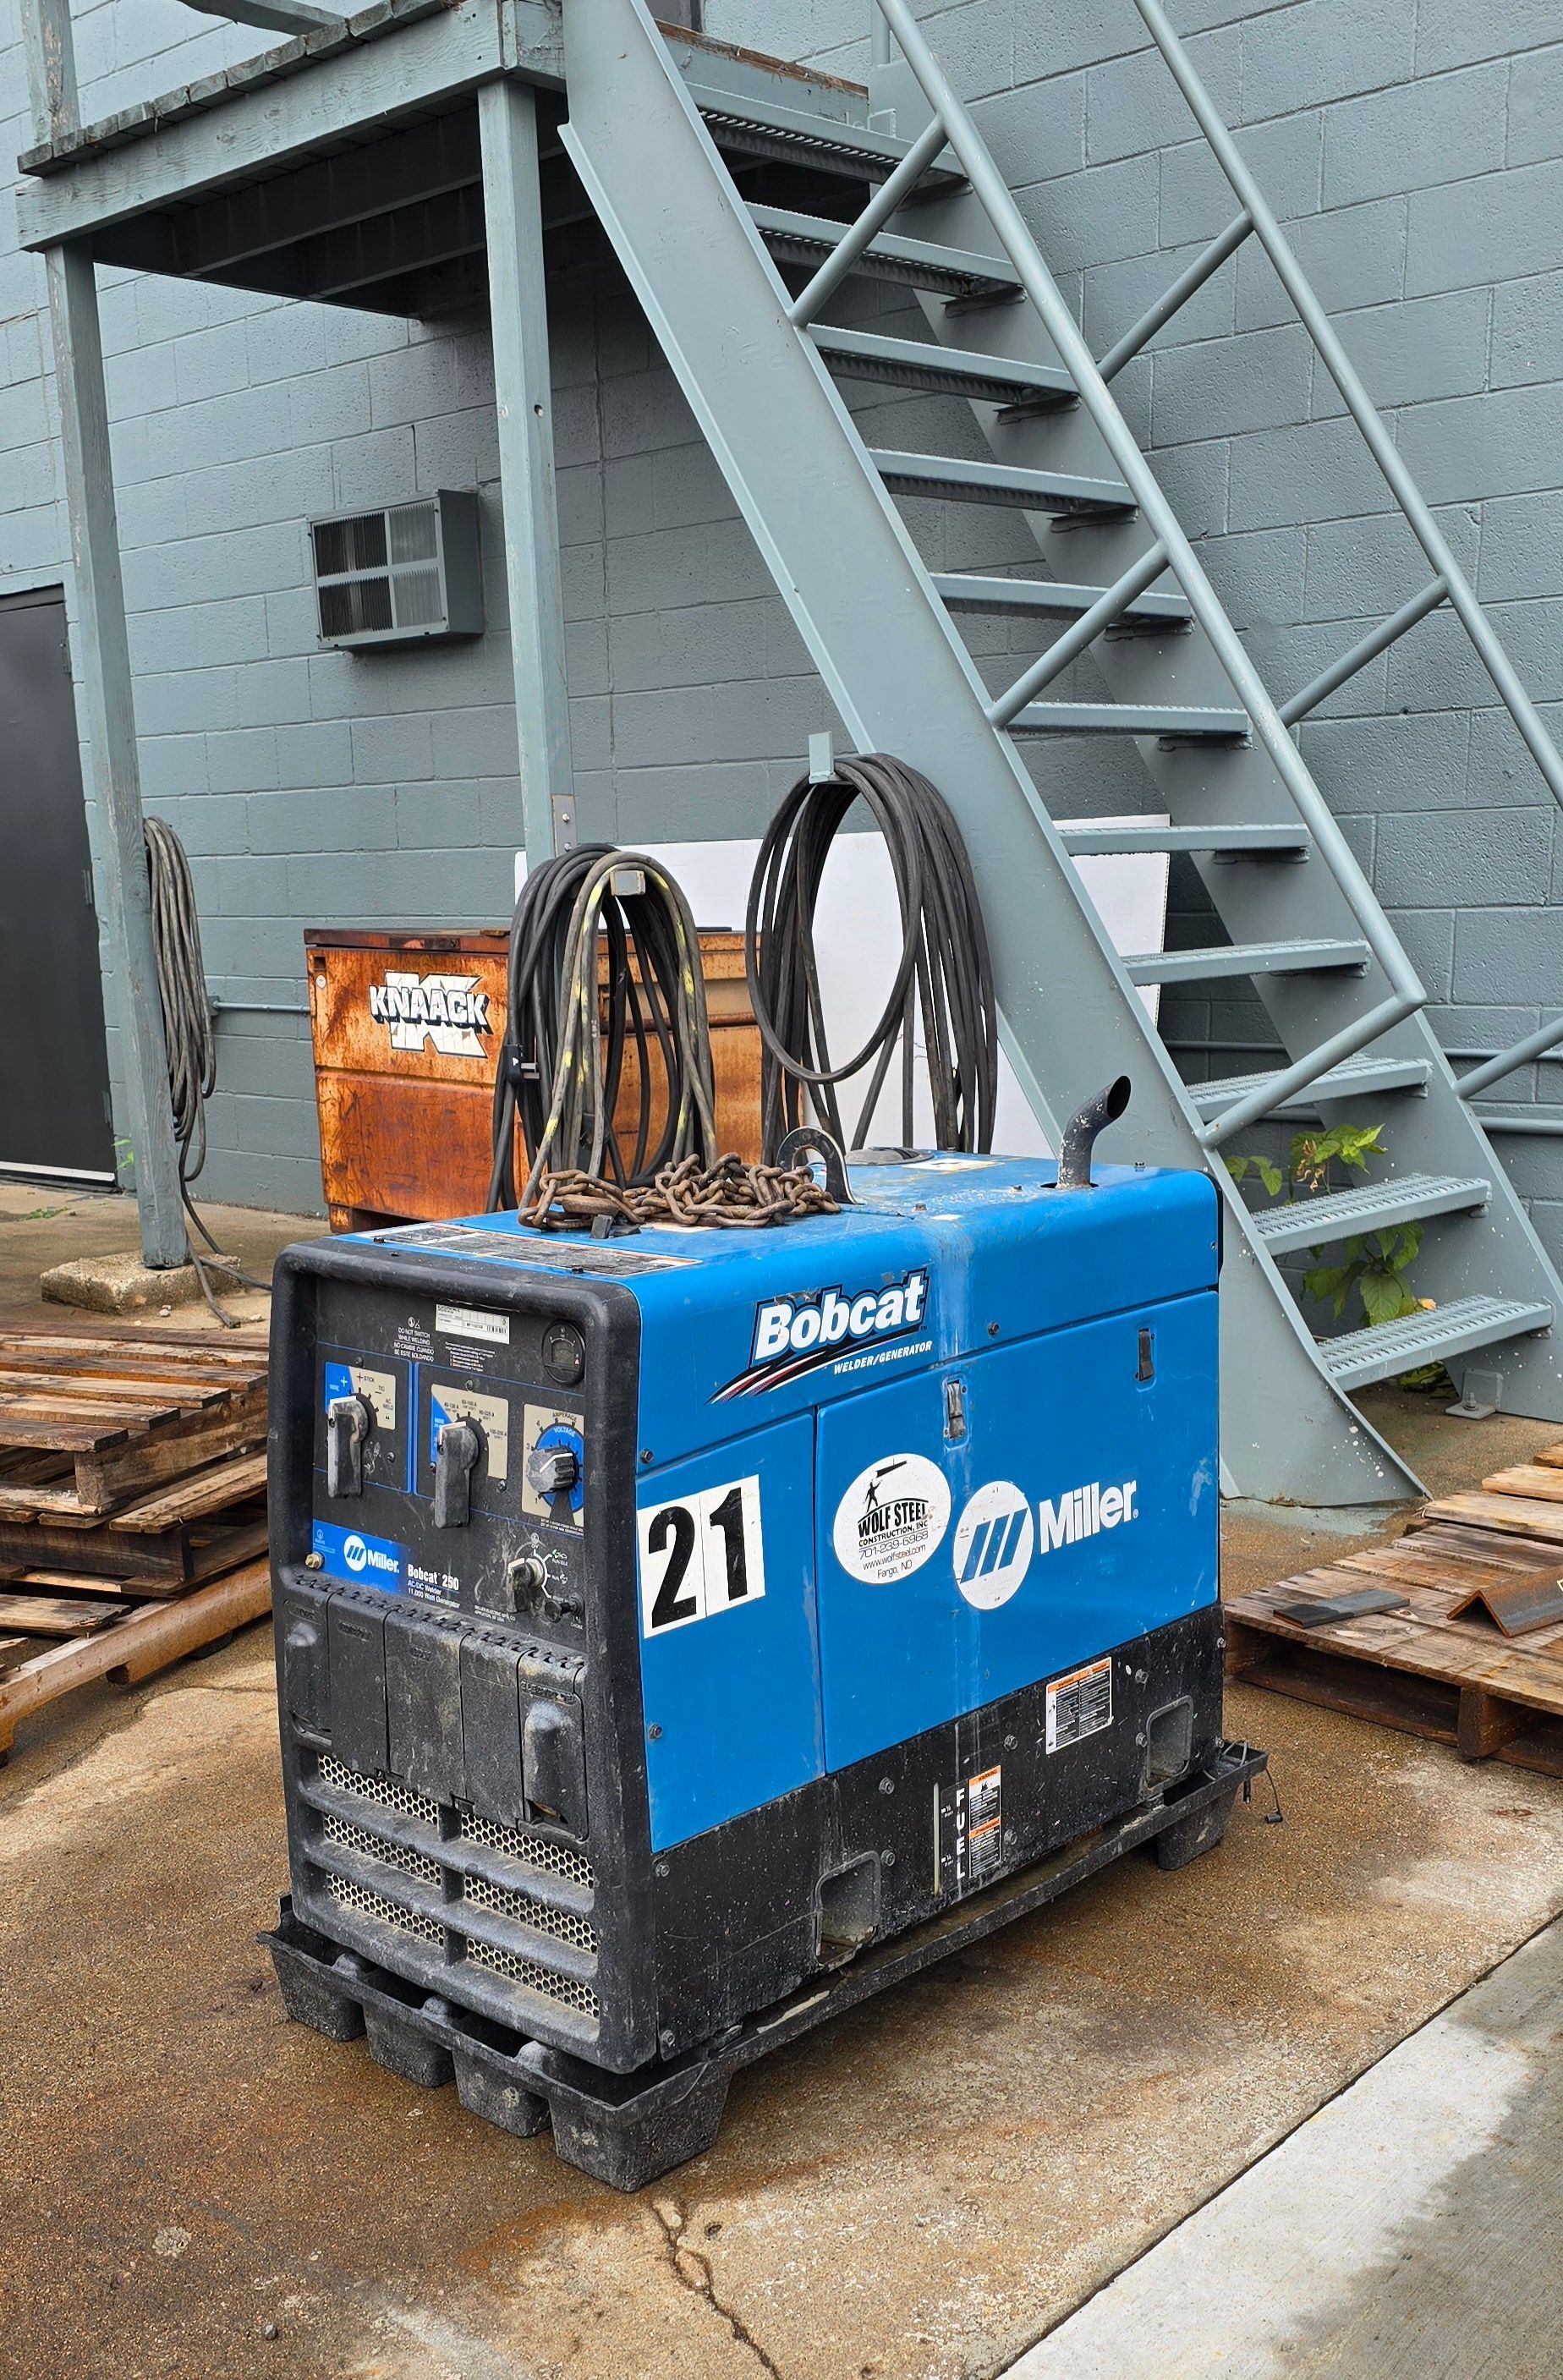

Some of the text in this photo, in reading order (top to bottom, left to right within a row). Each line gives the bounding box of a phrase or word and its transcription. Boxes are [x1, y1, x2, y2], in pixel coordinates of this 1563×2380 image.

[369, 984, 493, 1034] KNAACK
[754, 1275, 925, 1360] Bobcat
[834, 1341, 933, 1375] WELDER/GENERATOR
[553, 1426, 576, 1438] VOLTAGE
[858, 1502, 926, 1538] WOLF STEEL
[858, 1519, 929, 1548] CONSTRUCTION, INC
[1039, 1480, 1137, 1555] Miller
[367, 1549, 399, 1573] Miller
[649, 1487, 748, 1629] 21
[901, 1560, 913, 1571] ND
[407, 1563, 459, 1591] Bobcat 250
[956, 1787, 966, 1879] FUEL
